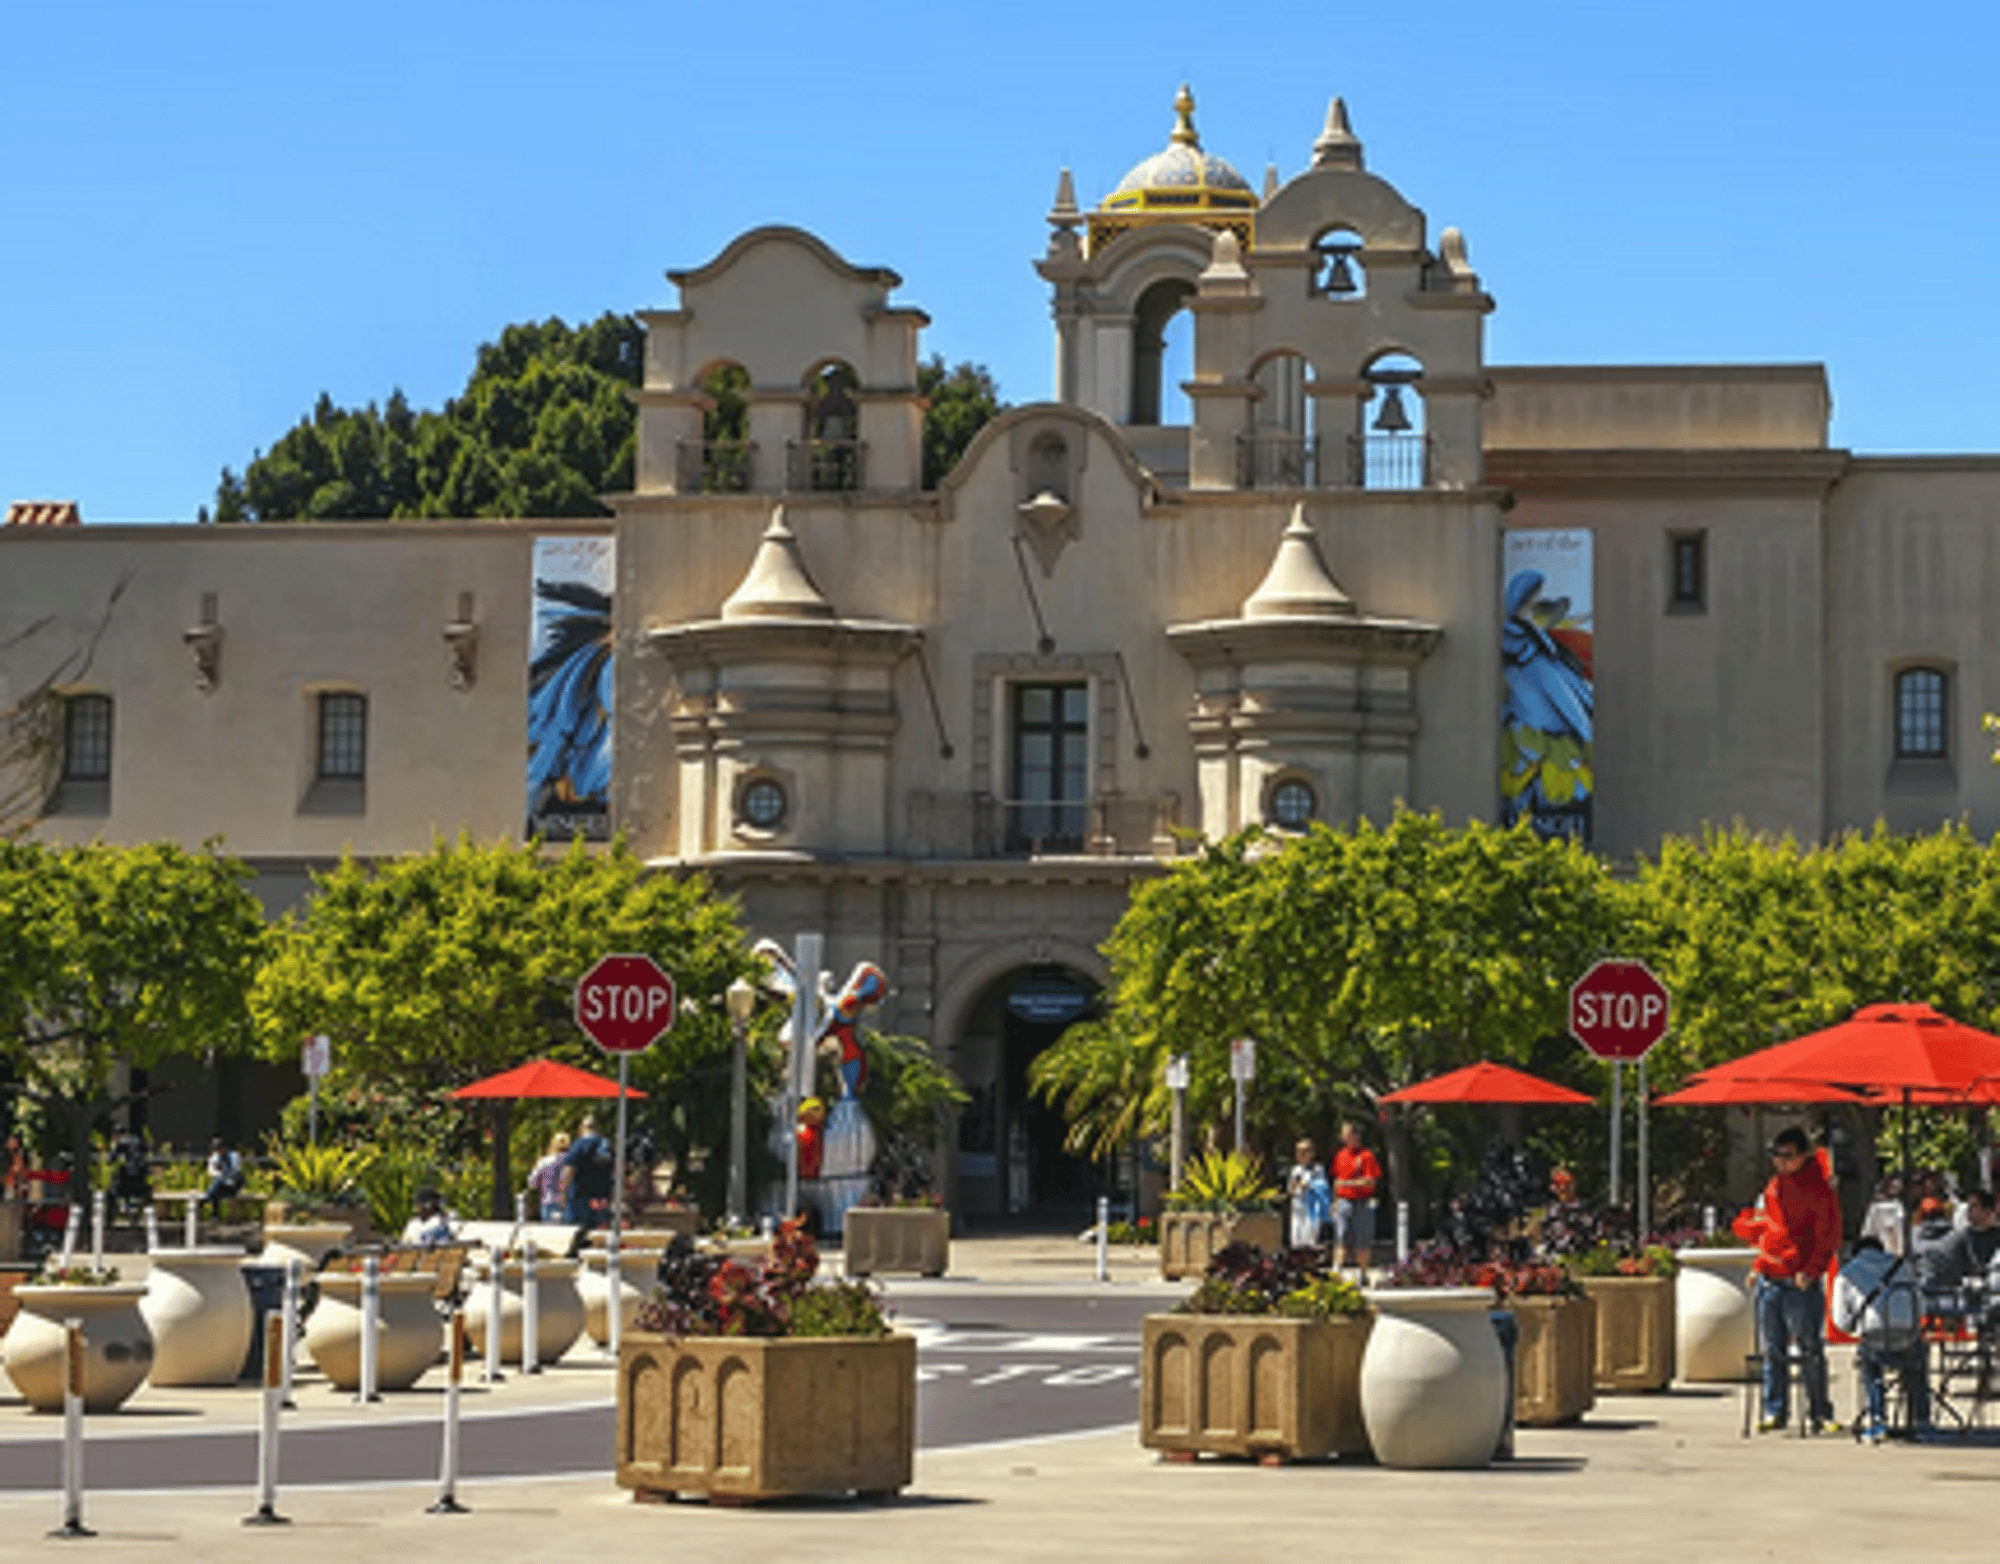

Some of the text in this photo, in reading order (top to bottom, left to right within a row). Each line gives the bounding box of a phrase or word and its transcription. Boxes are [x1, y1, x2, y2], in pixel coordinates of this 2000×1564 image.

[583, 985, 667, 1022] STOP
[1577, 991, 1663, 1030] STOP
[915, 1363, 1142, 1387] TO
